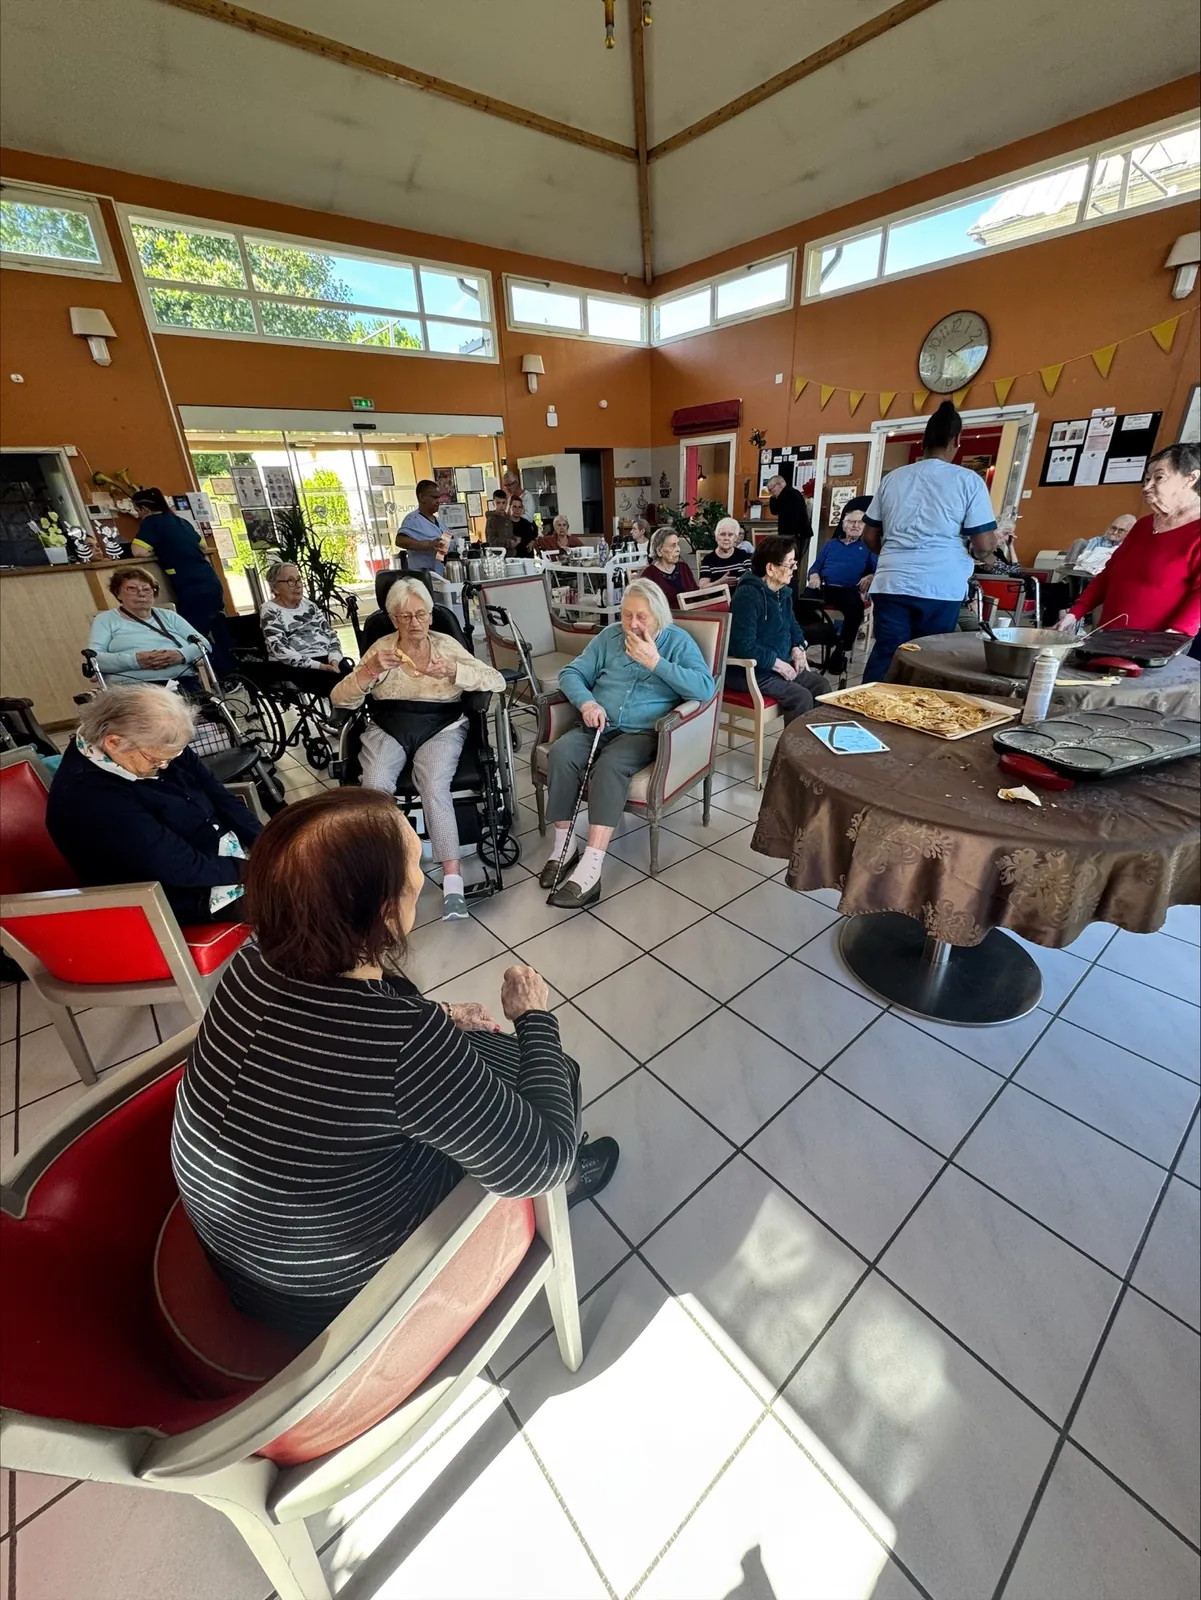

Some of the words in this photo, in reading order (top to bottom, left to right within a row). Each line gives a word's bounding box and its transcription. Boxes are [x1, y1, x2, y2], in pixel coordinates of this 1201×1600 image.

[952, 318, 962, 332] 12
[964, 320, 972, 333] 1
[939, 325, 950, 340] 11
[970, 328, 983, 340] 2
[929, 338, 941, 350] 10
[924, 354, 936, 363] 9
[934, 371, 943, 384] 7
